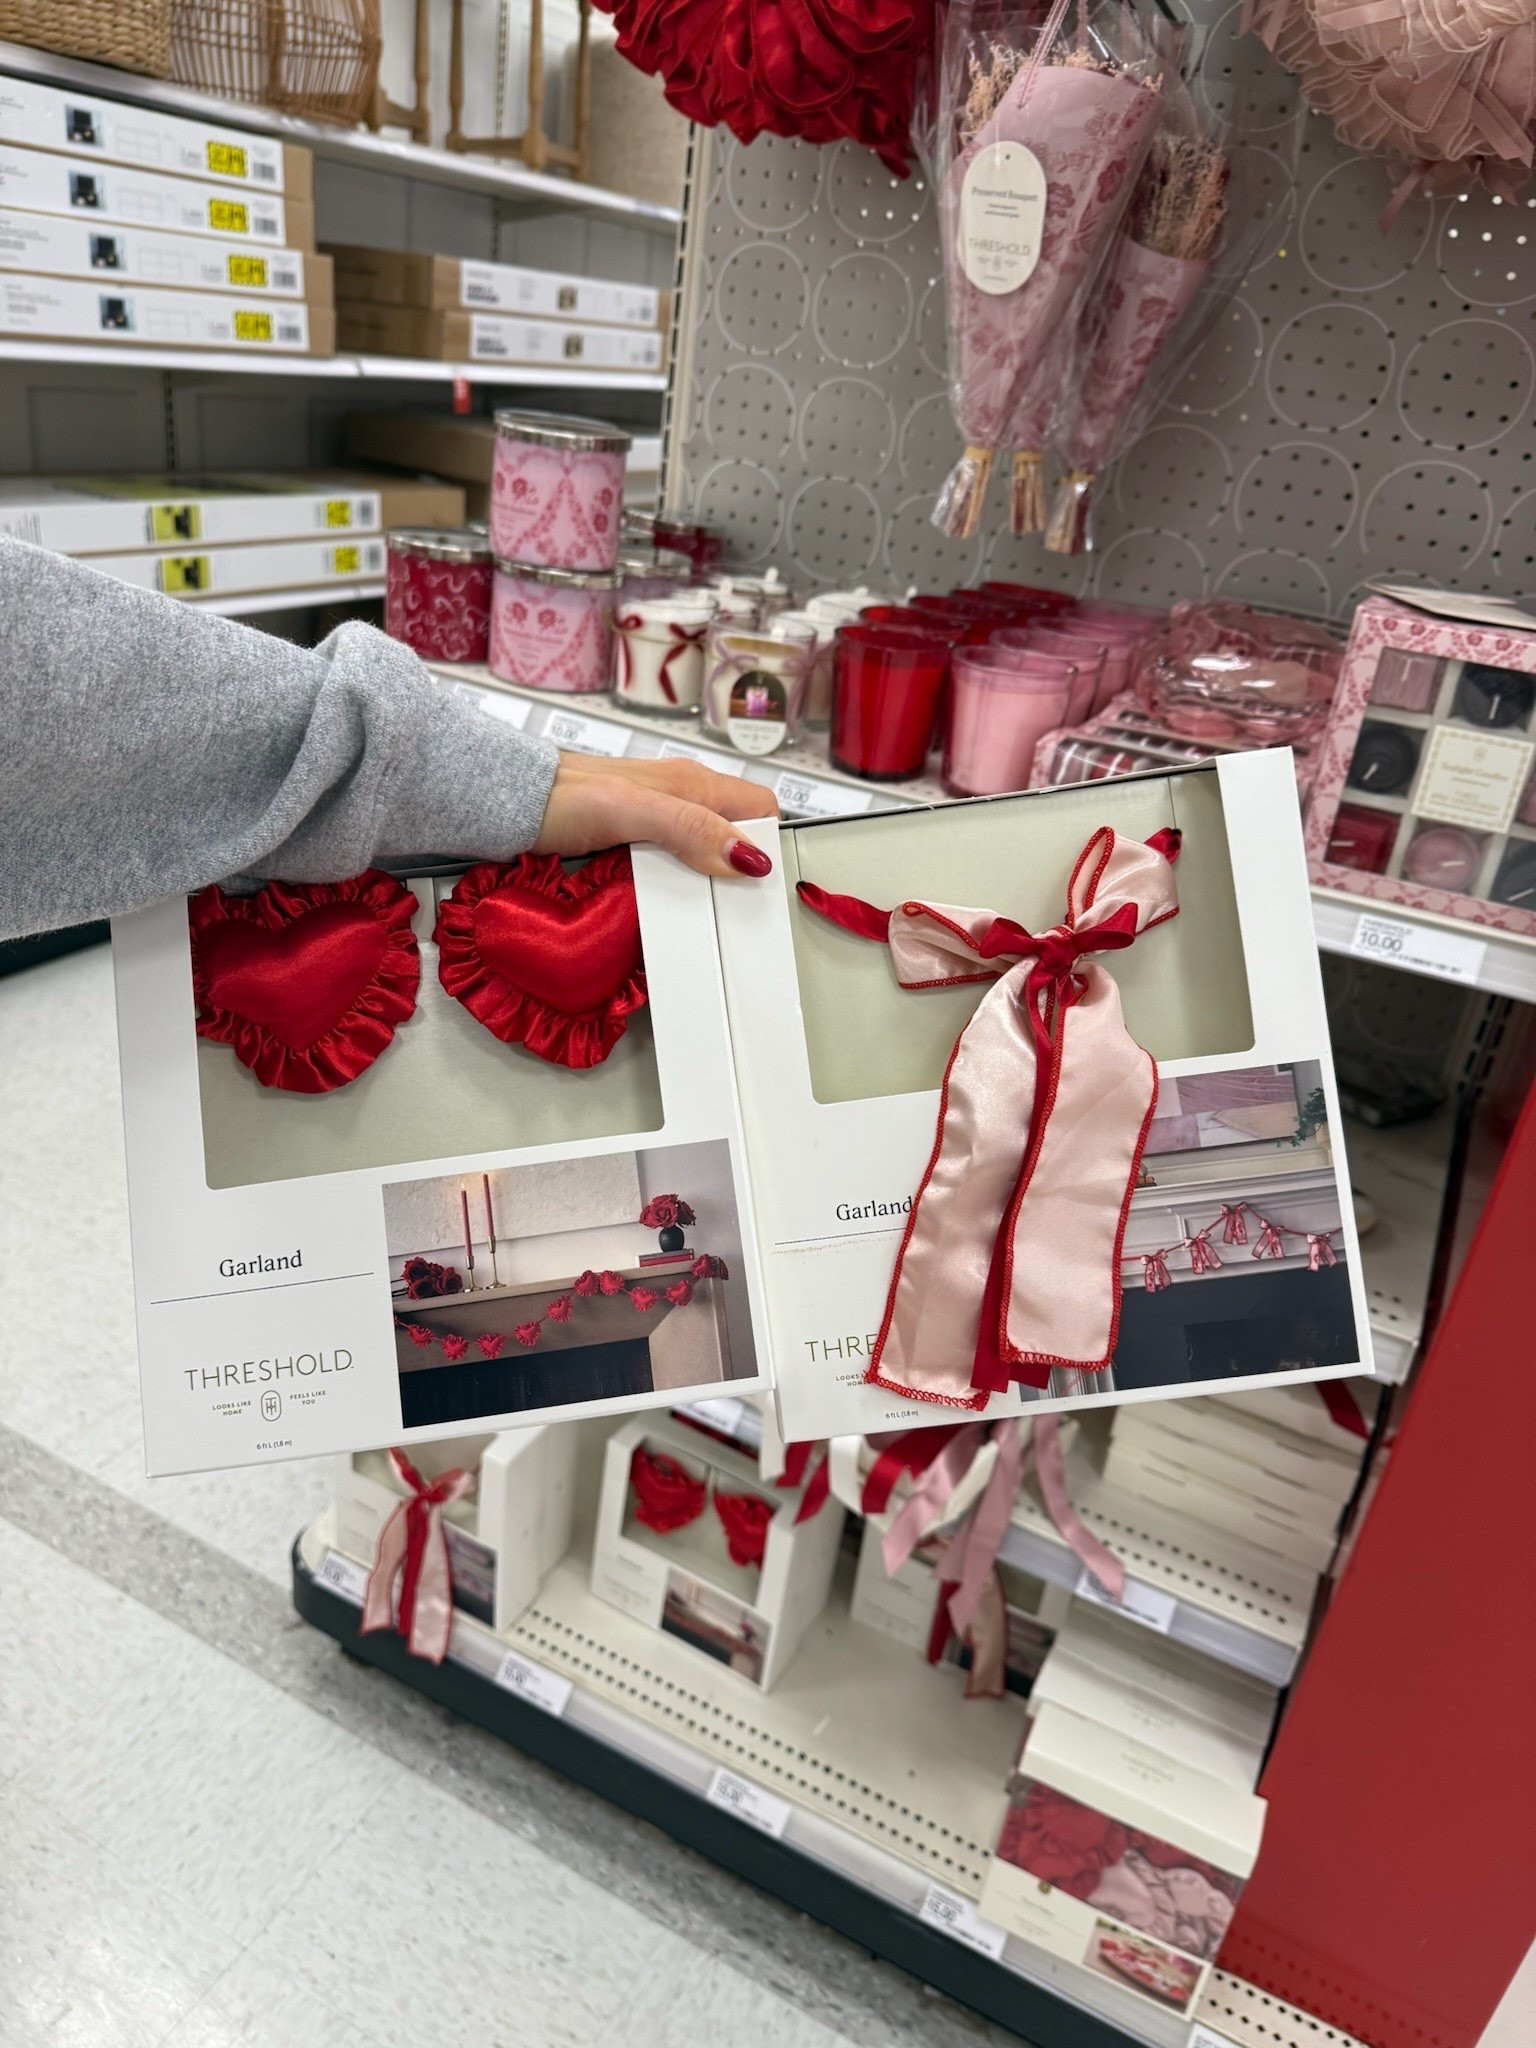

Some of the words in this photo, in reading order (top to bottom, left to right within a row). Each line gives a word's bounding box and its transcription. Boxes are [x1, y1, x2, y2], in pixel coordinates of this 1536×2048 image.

[968, 238, 1031, 256] THRESHOLD
[779, 787, 810, 804] 10.00
[1360, 931, 1403, 953] 10.00
[836, 1196, 914, 1221] Garland
[219, 1249, 303, 1278] Garland
[805, 1333, 878, 1363] THRE
[184, 1349, 354, 1391] THRESHOLD
[290, 1392, 310, 1400] FEELS
[311, 1390, 327, 1398] LIKE
[302, 1397, 316, 1406] YOU
[212, 1402, 236, 1411] LOOKS
[236, 1400, 252, 1409] LIKE
[222, 1408, 242, 1417] HOME
